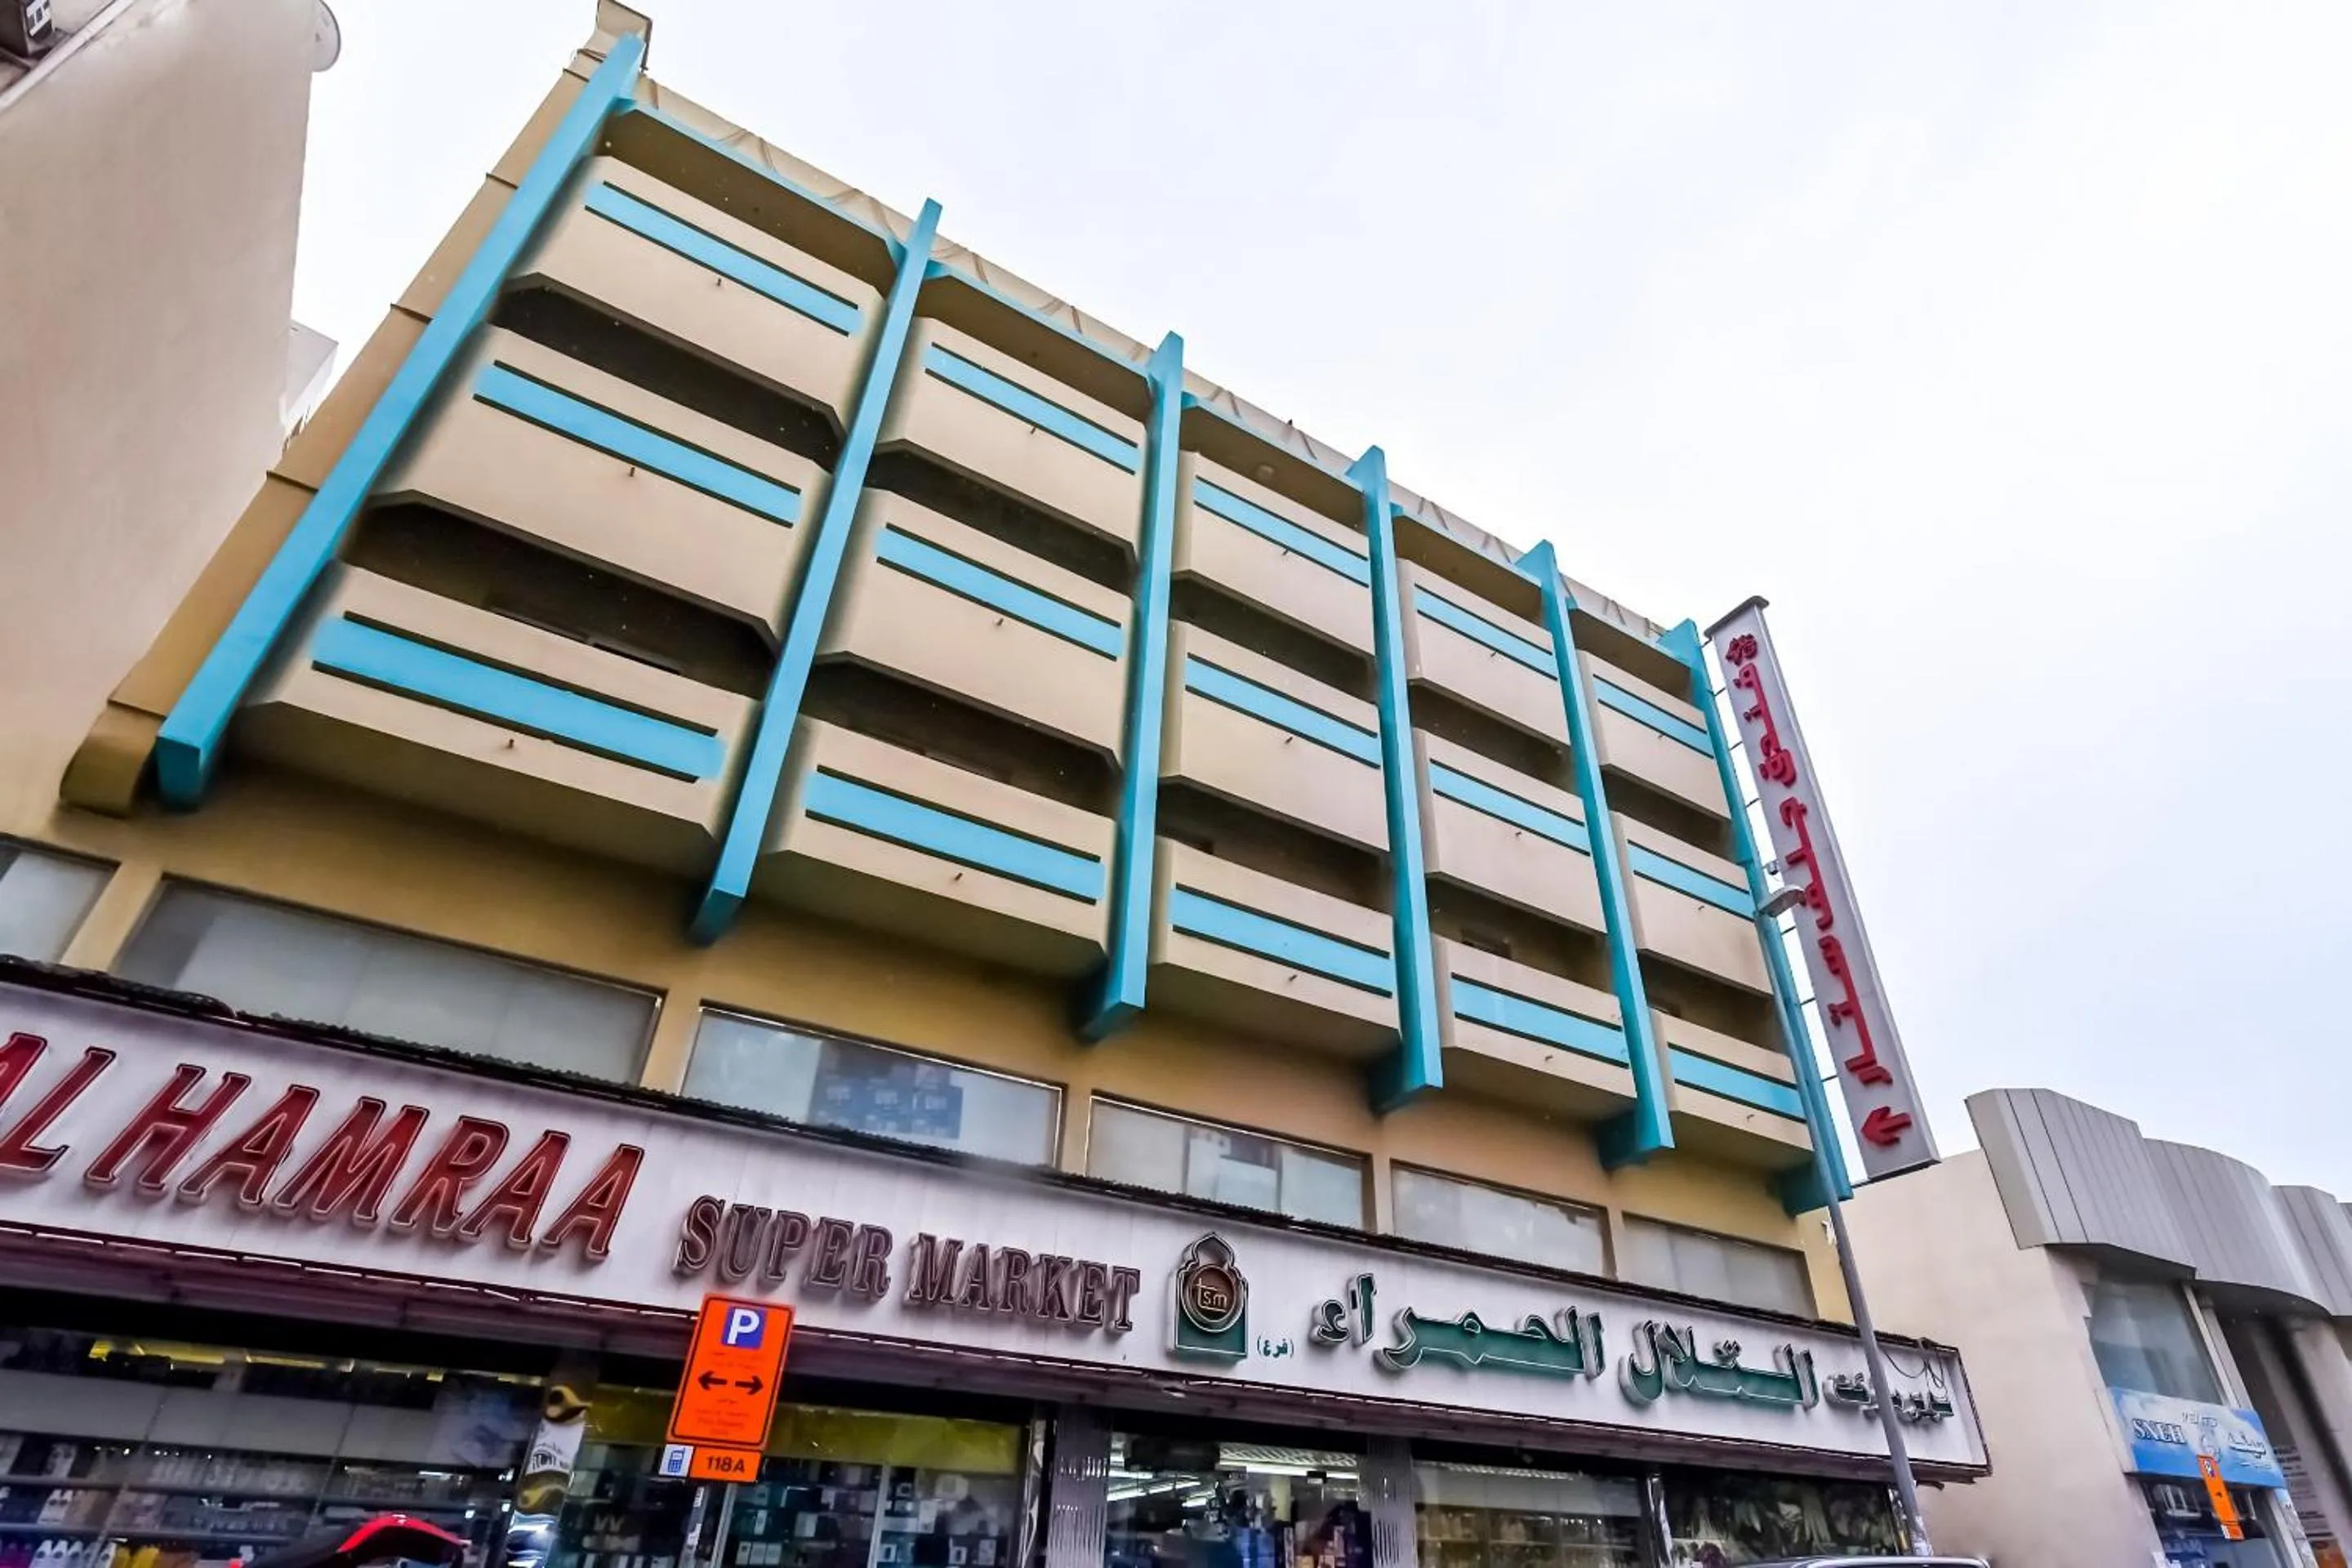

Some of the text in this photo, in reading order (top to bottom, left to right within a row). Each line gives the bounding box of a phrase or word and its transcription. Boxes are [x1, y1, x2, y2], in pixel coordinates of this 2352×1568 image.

[1733, 662, 1796, 786] فندق
[1819, 935, 1892, 1085] ستار
[83, 1063, 644, 1263] HAMRAA
[677, 1194, 894, 1298] SUPER
[909, 1232, 1141, 1332] MARKET
[728, 1308, 760, 1346] P
[1310, 1273, 1606, 1379] الحمراء
[705, 1455, 746, 1475] 118A
